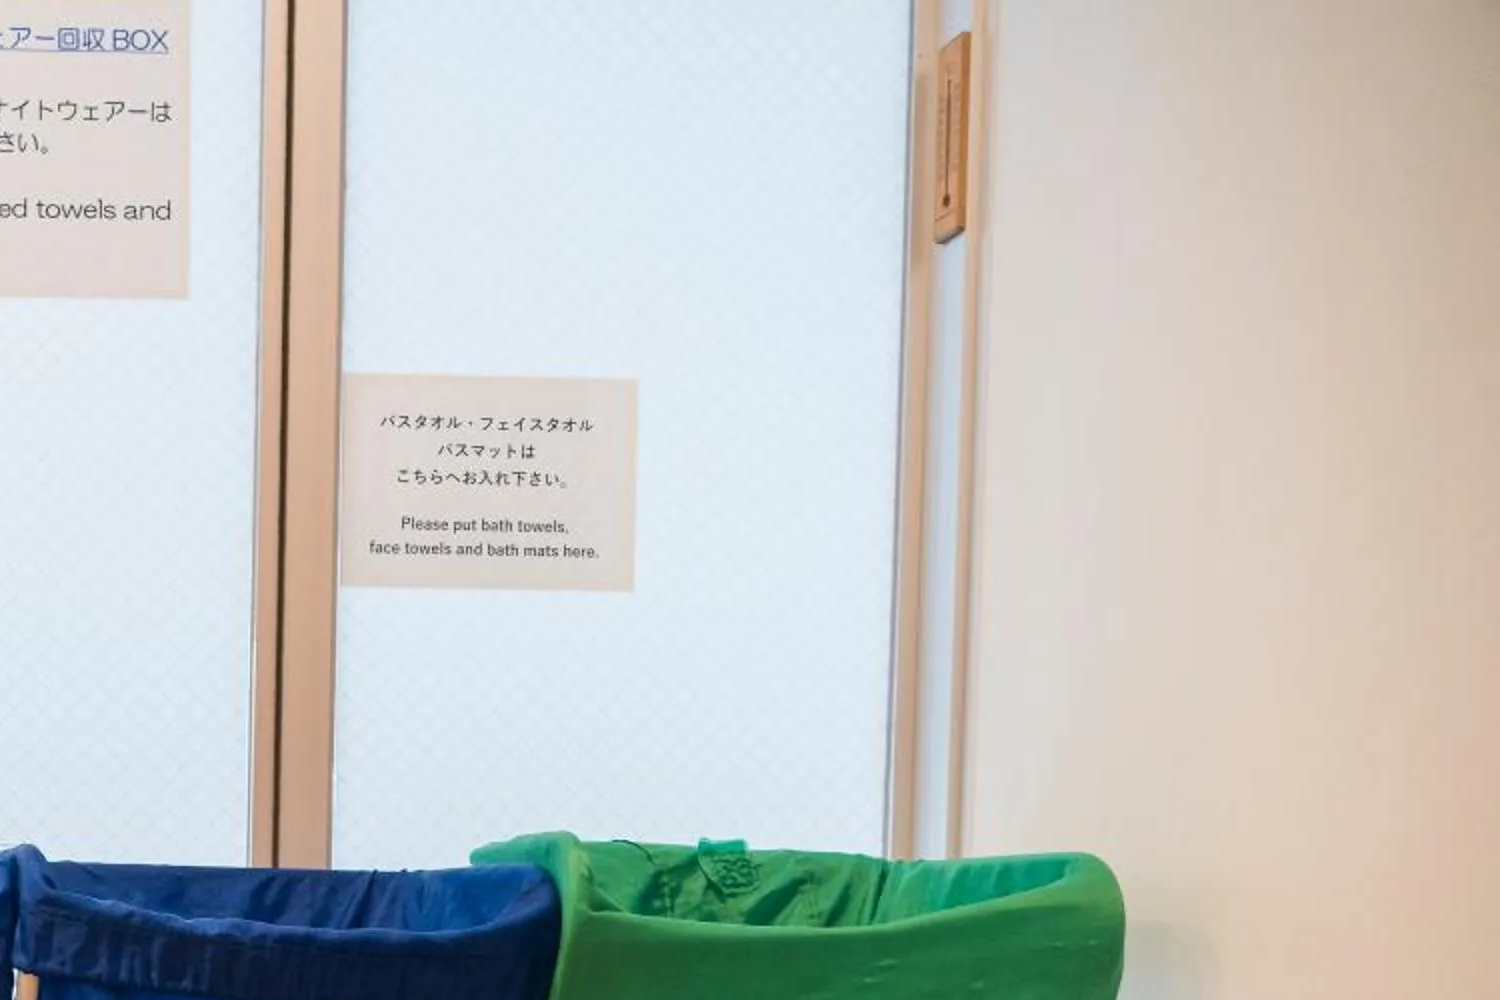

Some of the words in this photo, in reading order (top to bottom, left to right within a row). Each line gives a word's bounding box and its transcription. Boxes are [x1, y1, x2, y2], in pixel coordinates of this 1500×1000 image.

[36, 198, 117, 220] towels
[123, 200, 172, 221] and
[380, 415, 595, 433] バスタオル・フェイスタオル
[437, 443, 536, 460] バスマットは
[397, 469, 567, 489] こちらへお入れ下さい。
[400, 515, 449, 531] Please
[453, 518, 477, 534] put
[481, 517, 513, 532] bath
[369, 540, 400, 555] face
[404, 540, 451, 556] towels
[455, 542, 483, 557] and
[486, 542, 519, 557] bath
[523, 544, 559, 559] mats
[562, 543, 599, 559] here.
